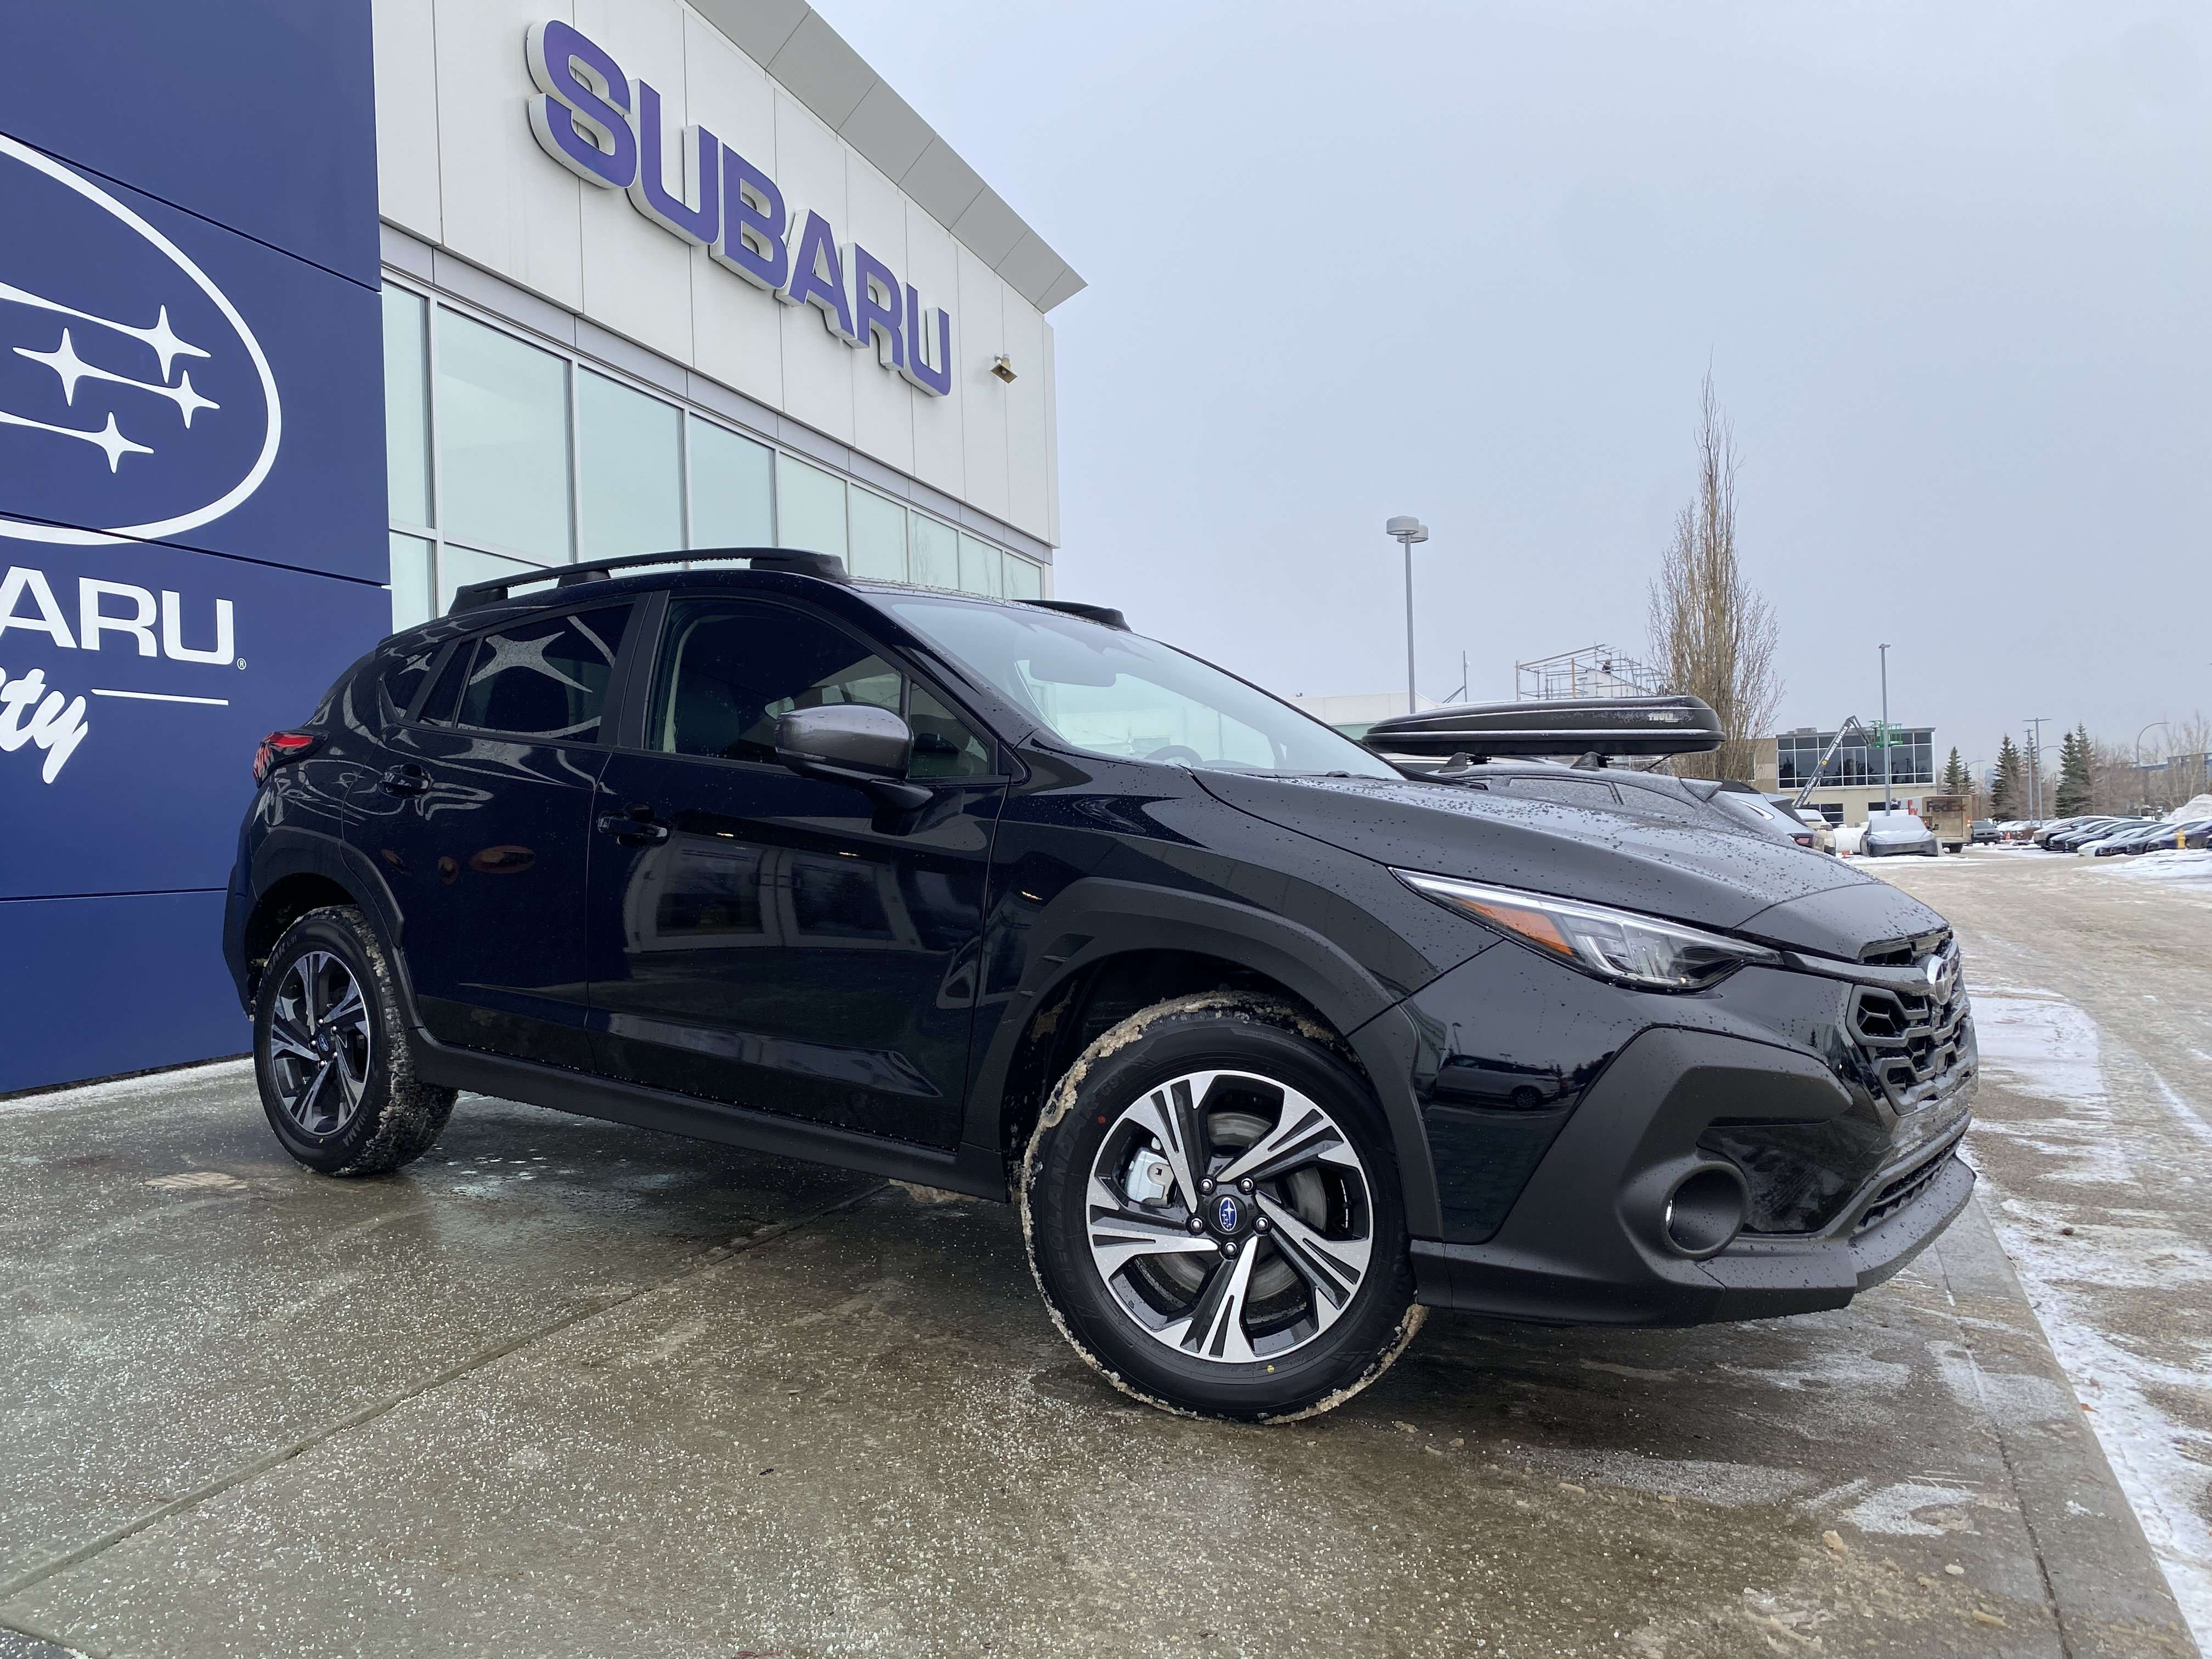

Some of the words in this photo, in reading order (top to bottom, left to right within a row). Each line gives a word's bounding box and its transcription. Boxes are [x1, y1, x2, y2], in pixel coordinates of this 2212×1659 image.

[529, 20, 951, 396] SUBARU
[0, 667, 88, 784] ty
[1926, 800, 1967, 812] FedEx
